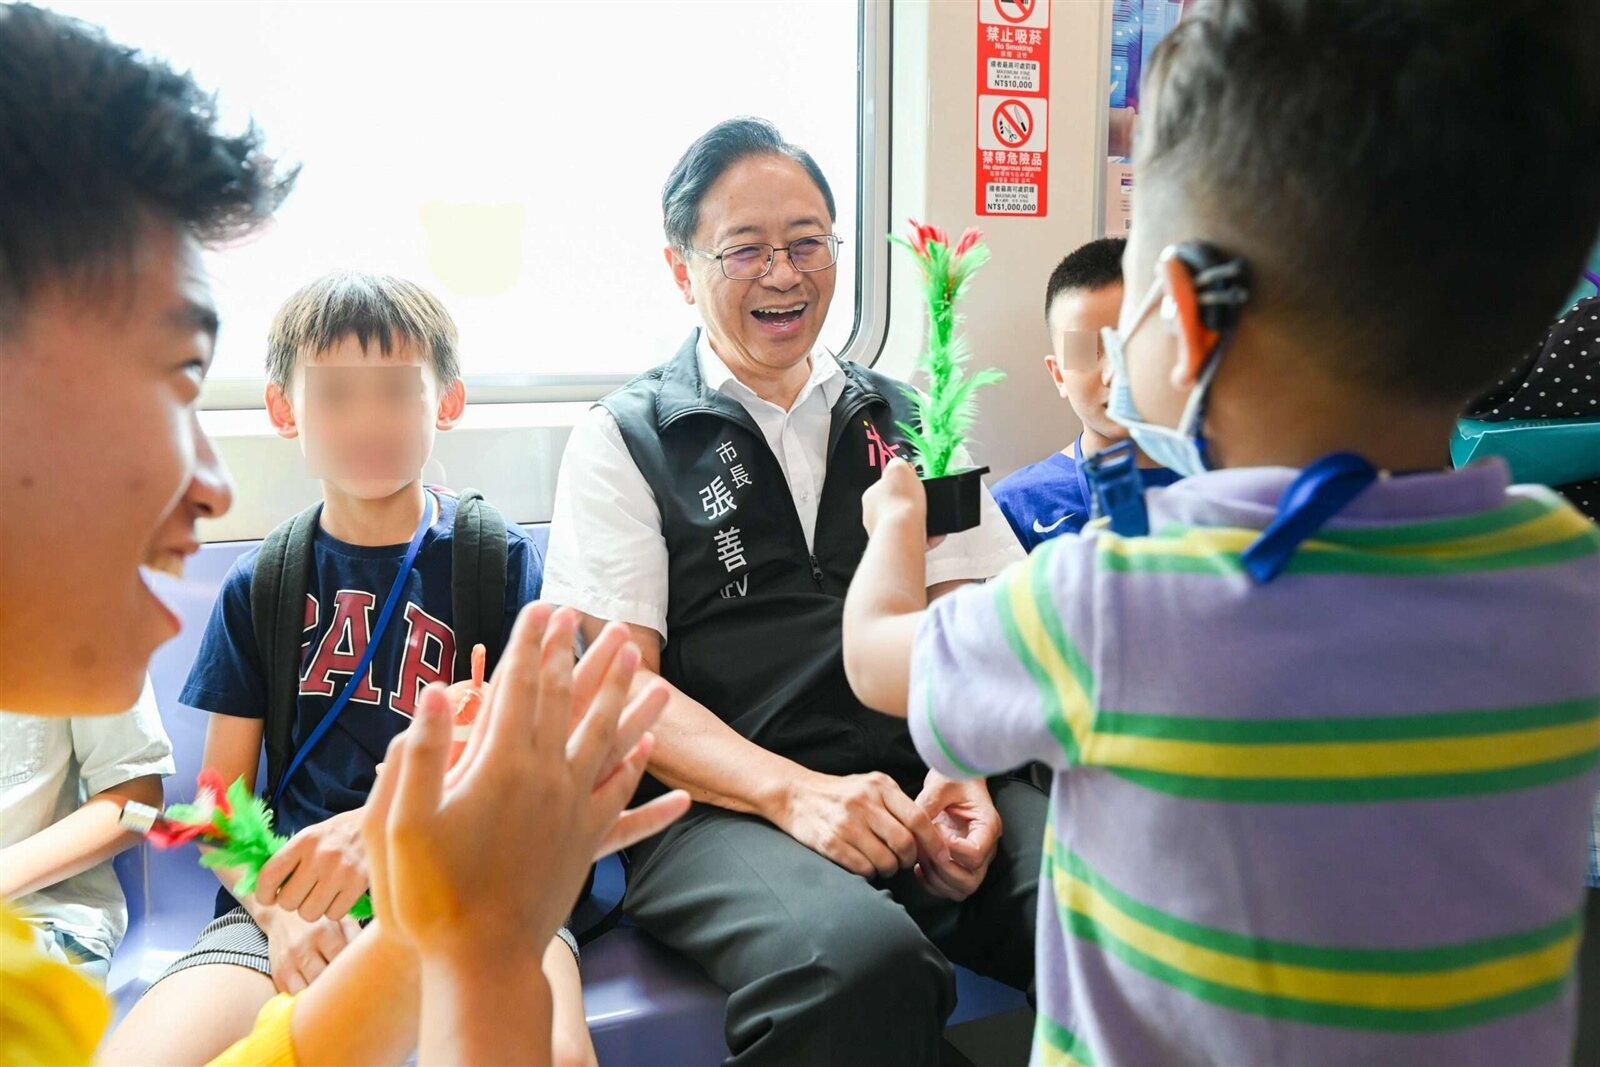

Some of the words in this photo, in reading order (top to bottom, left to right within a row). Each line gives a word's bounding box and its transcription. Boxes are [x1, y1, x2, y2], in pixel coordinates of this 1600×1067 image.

[986, 26, 1042, 45] 禁止吸菸
[1006, 43, 1033, 53] Smoking
[994, 80, 1033, 88] NT$10,000
[987, 203, 1036, 211] NT$1,000,000
[716, 441, 752, 489] 市長
